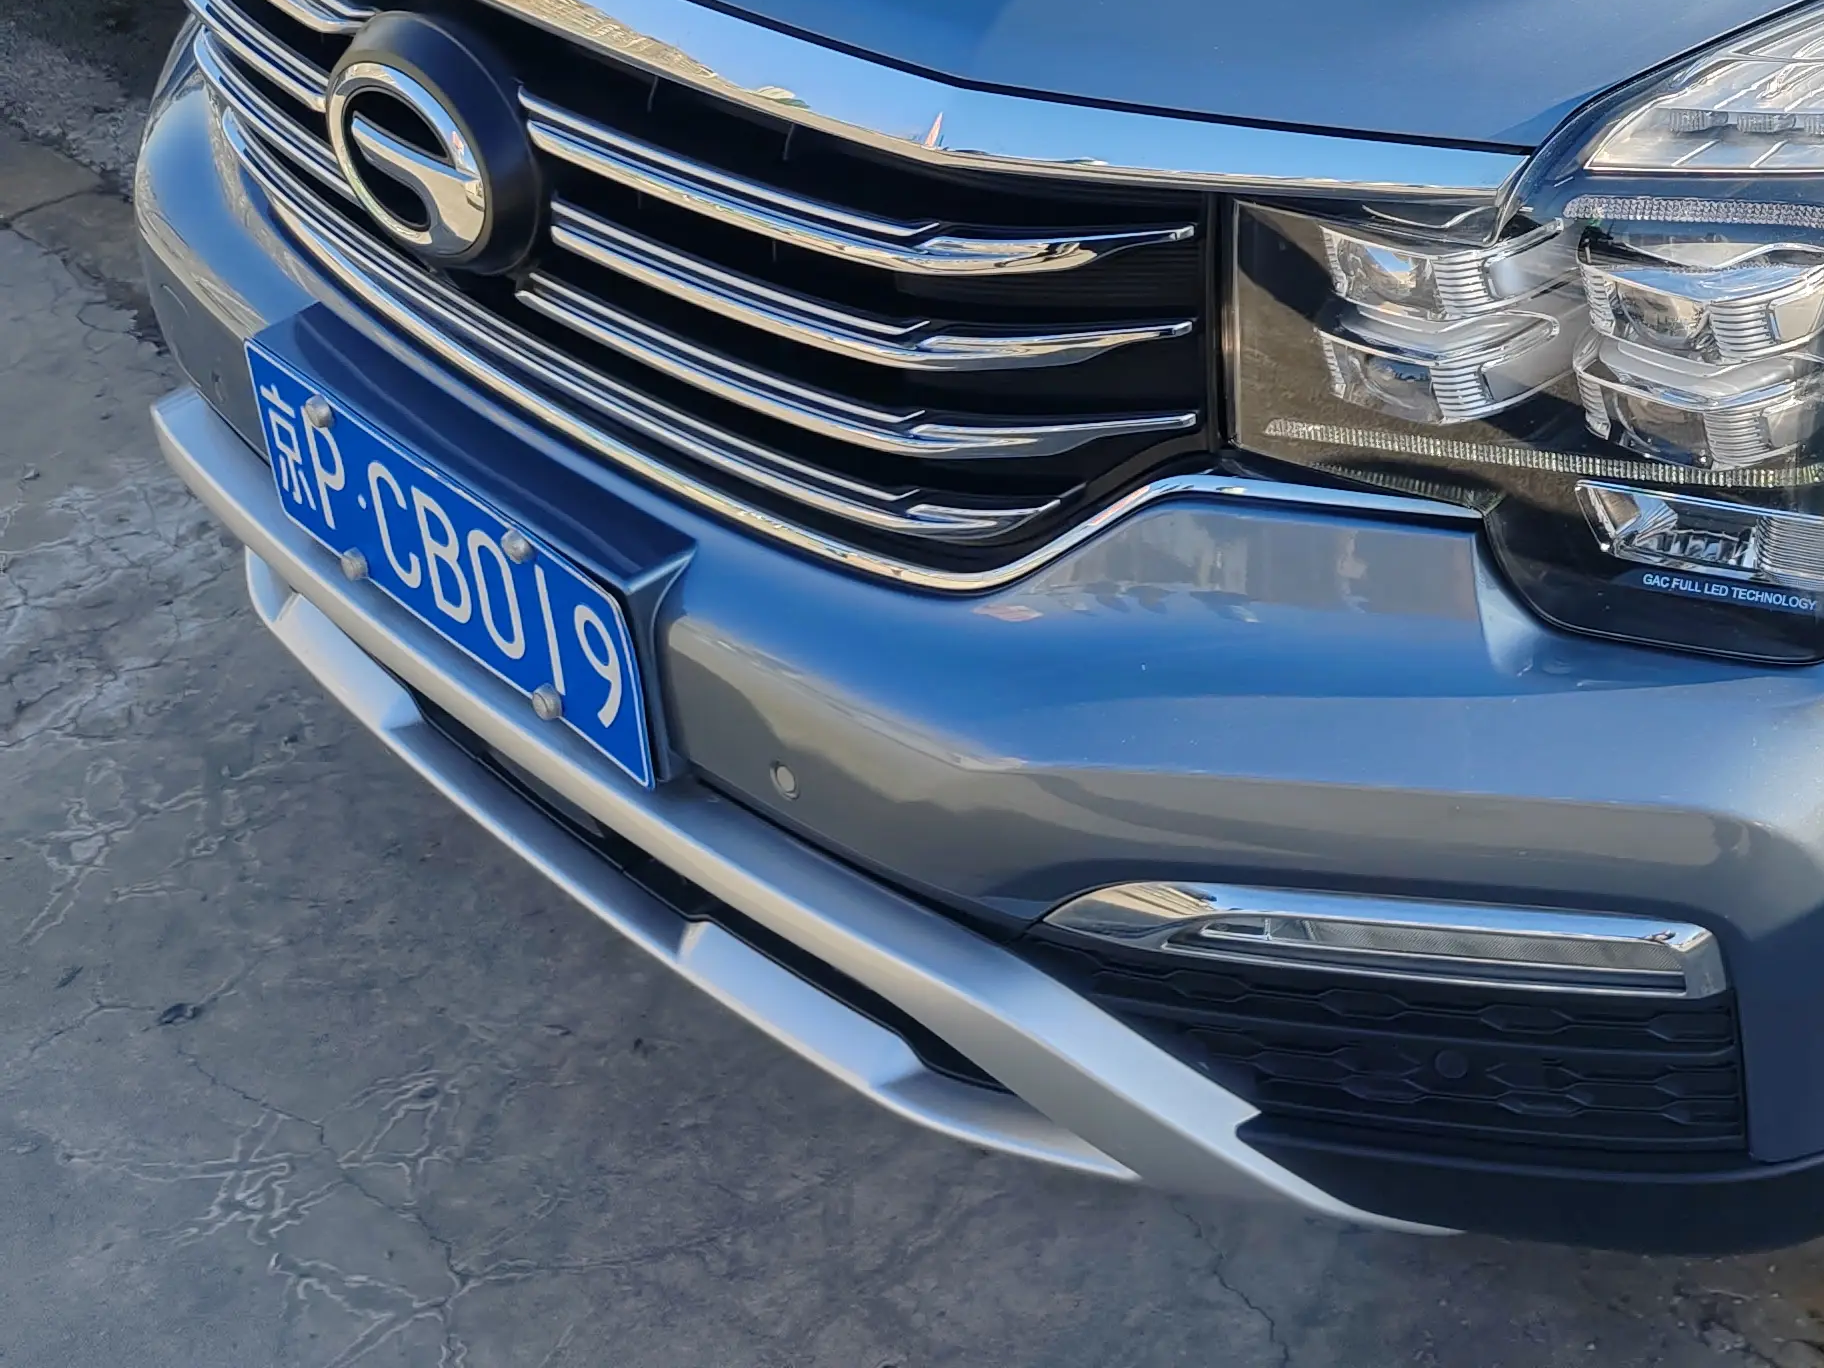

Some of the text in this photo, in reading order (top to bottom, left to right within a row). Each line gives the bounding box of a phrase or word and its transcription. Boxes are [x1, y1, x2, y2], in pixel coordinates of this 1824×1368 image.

[1642, 573, 1817, 611] GAC FULL LED TECHNOLOGY
